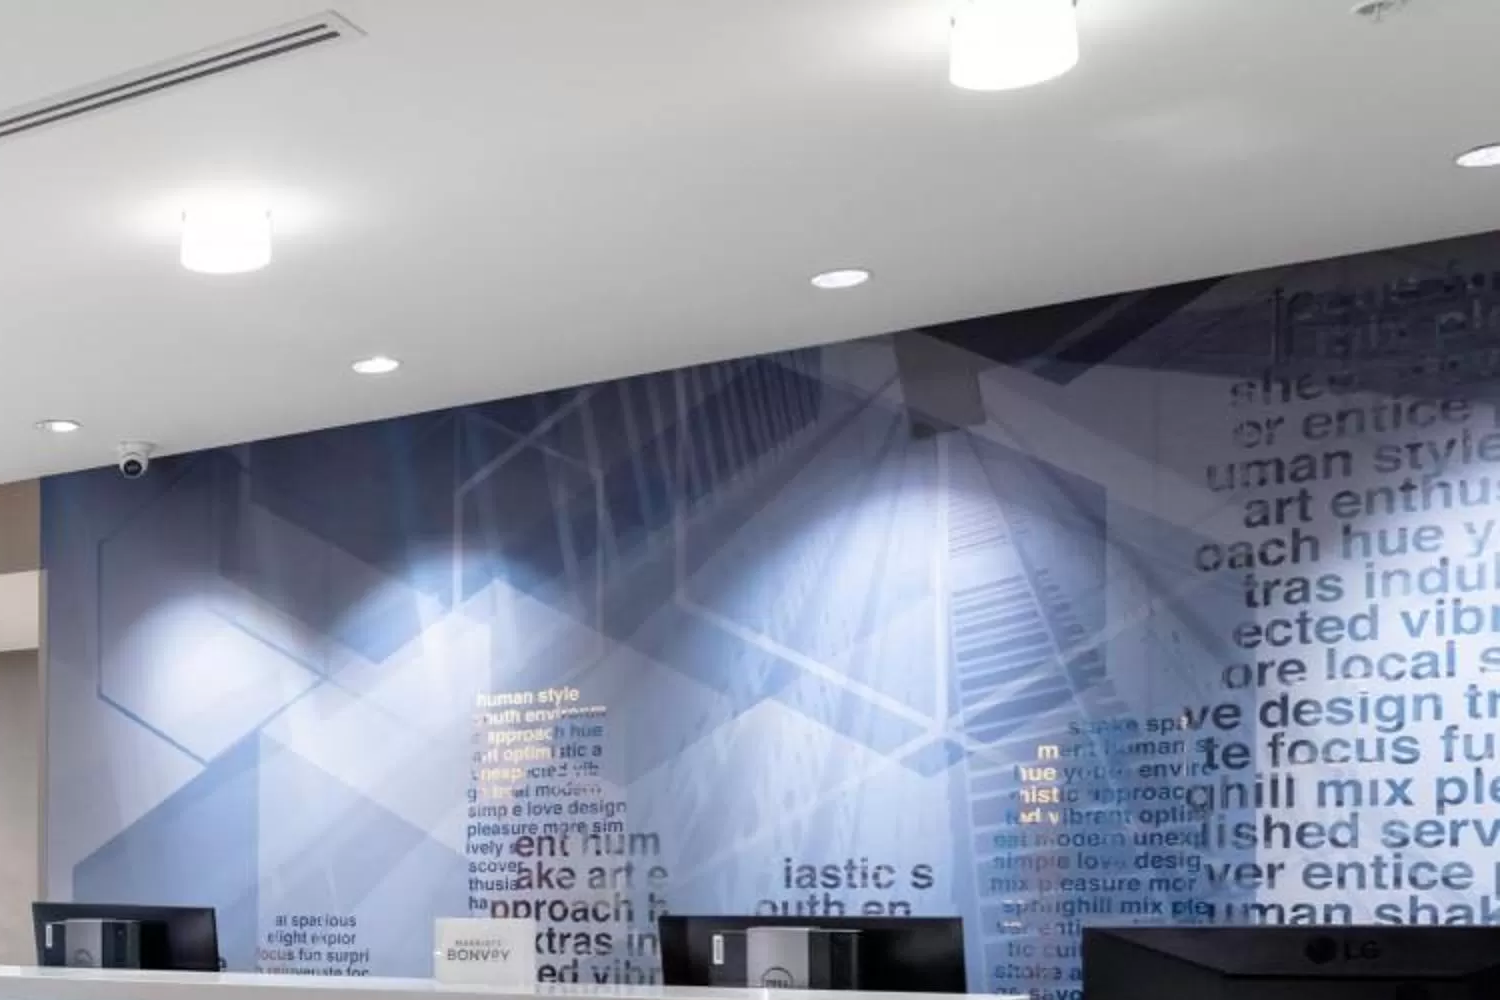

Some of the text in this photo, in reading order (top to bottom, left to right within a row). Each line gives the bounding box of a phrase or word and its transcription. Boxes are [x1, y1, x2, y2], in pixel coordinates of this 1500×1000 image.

[1302, 398, 1472, 441] entice
[1373, 427, 1500, 478] style
[1243, 474, 1500, 530] art enthu
[1342, 523, 1444, 560] hue
[1232, 603, 1379, 650] ected
[1325, 640, 1456, 682] local
[476, 685, 580, 708] human style
[1259, 690, 1444, 734] design
[1268, 731, 1421, 769] focus
[1440, 724, 1497, 763] fu
[527, 801, 563, 817] love
[568, 799, 627, 818] design
[1317, 775, 1414, 809] mix
[467, 820, 539, 839] pleasure
[1380, 817, 1500, 849] serv
[783, 857, 934, 890] iastic s
[1204, 852, 1474, 892] ver entice
